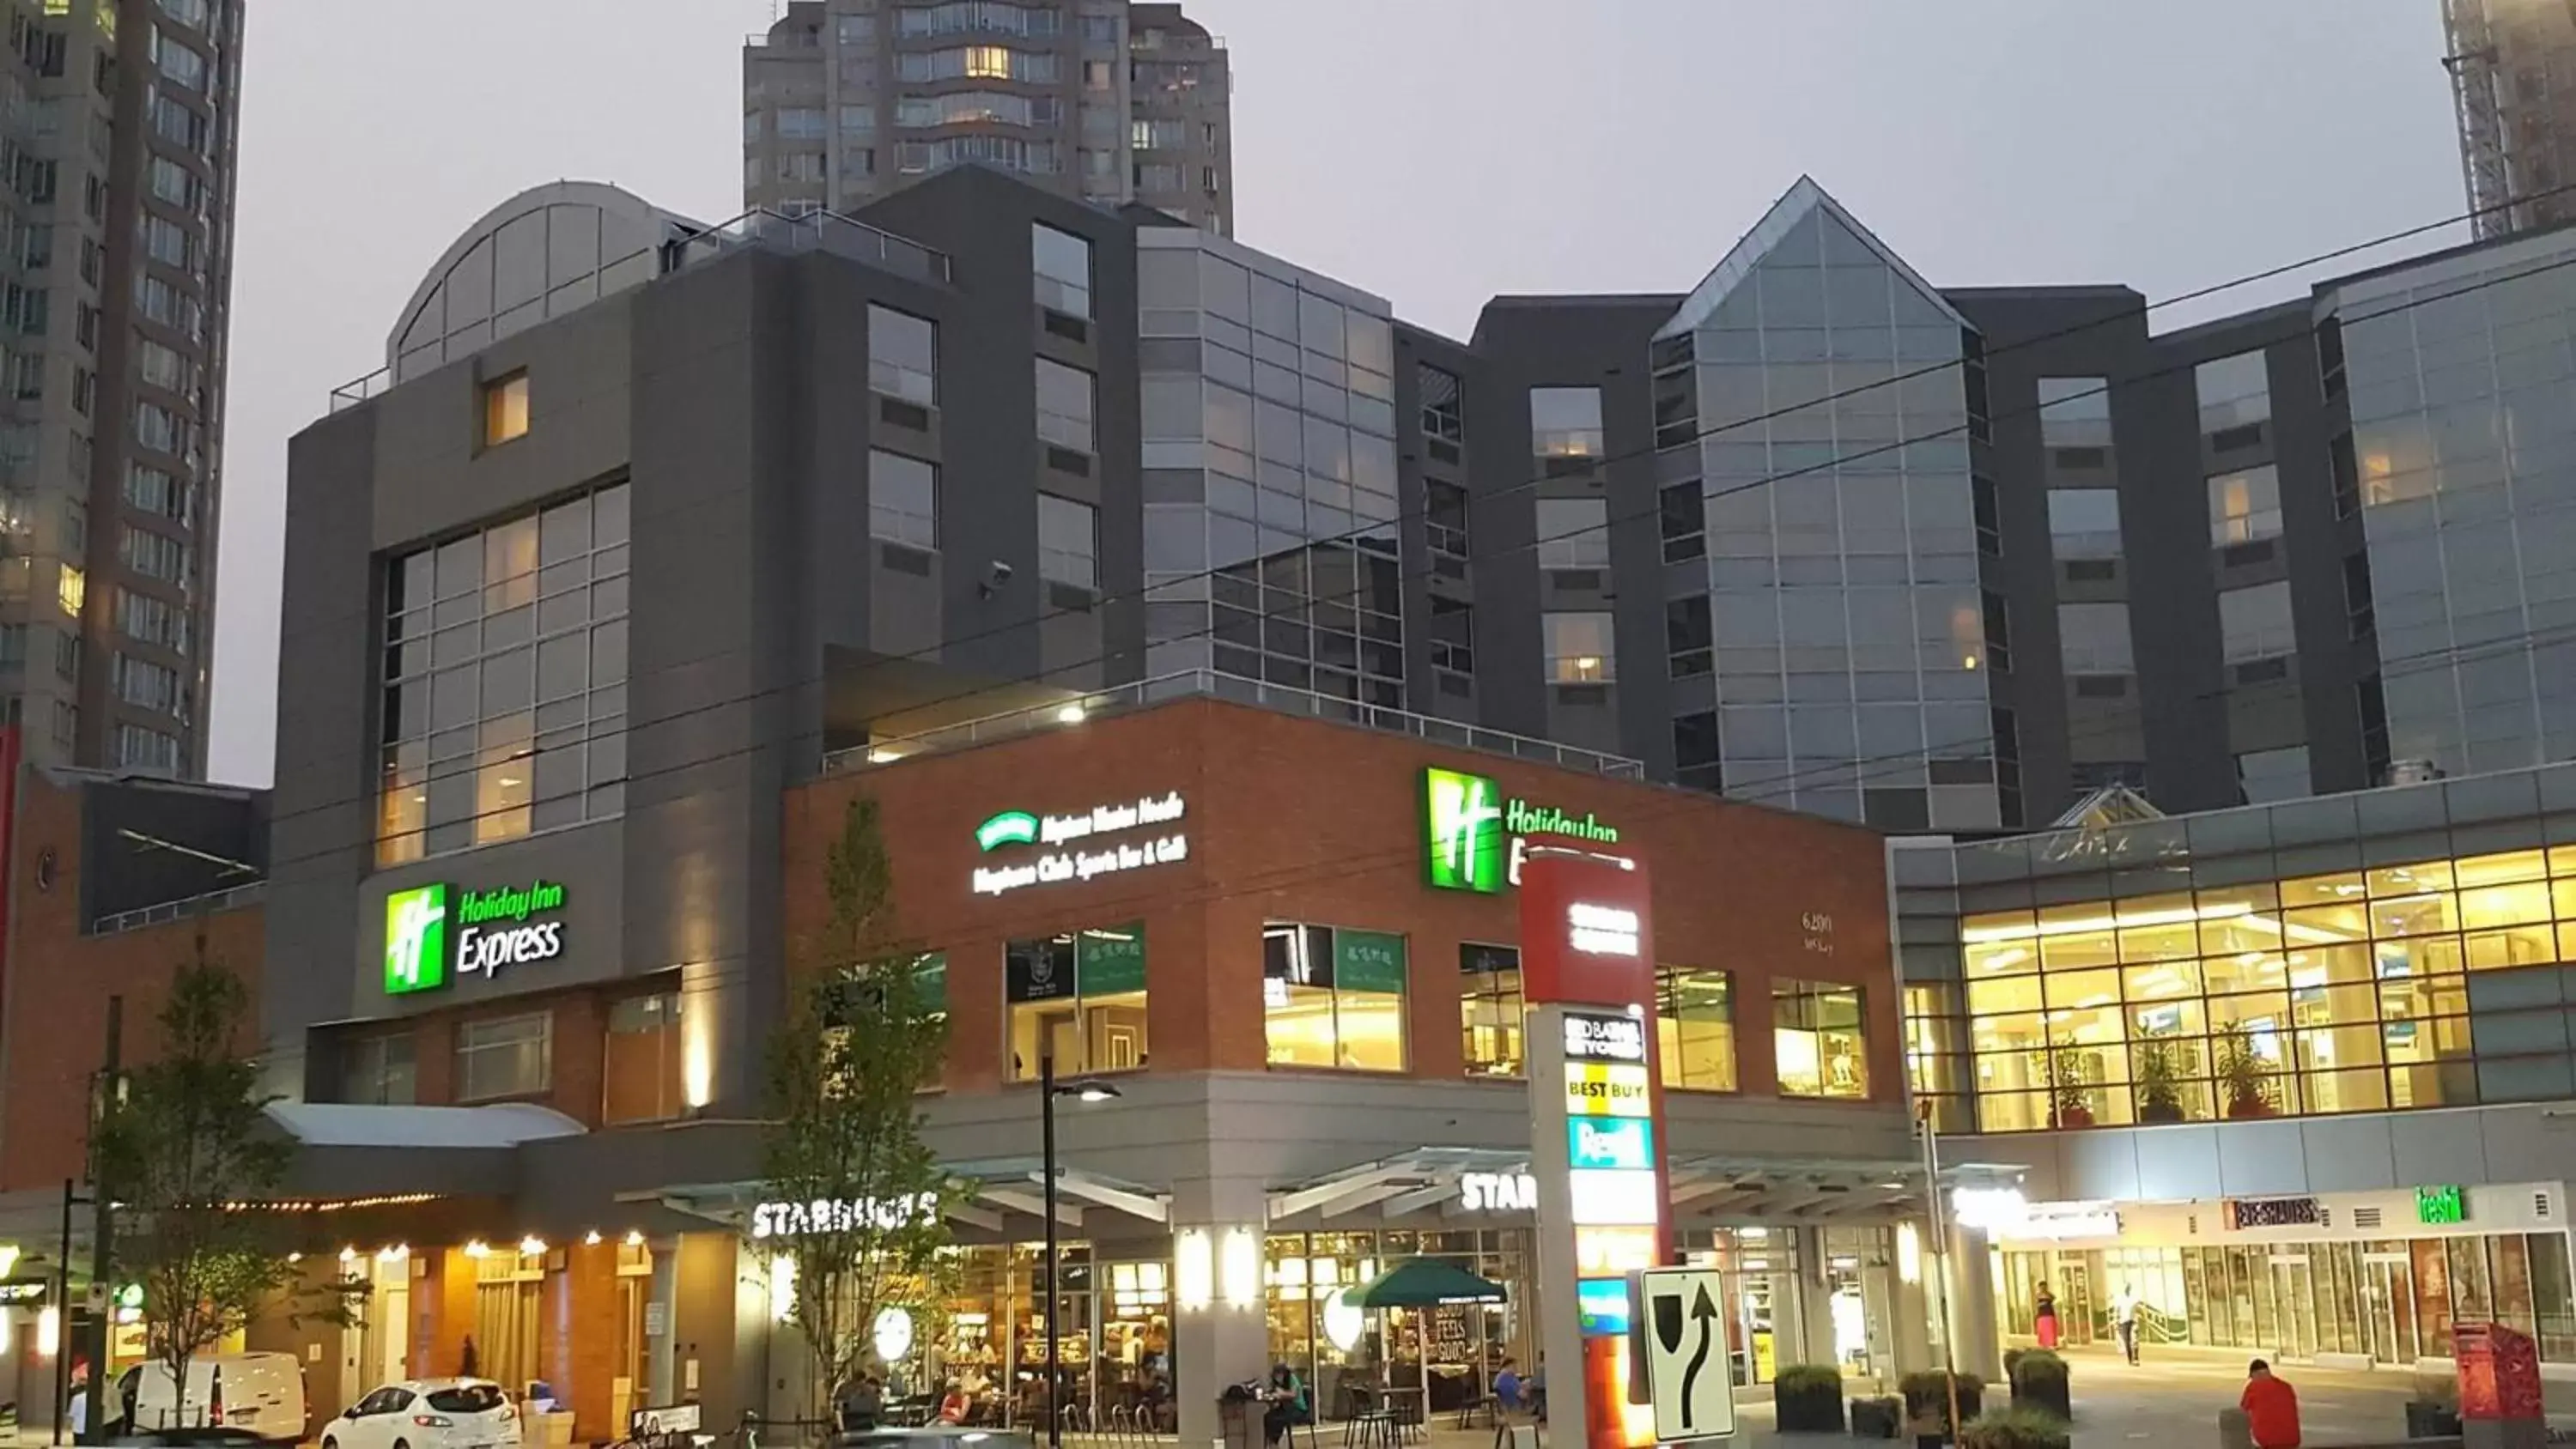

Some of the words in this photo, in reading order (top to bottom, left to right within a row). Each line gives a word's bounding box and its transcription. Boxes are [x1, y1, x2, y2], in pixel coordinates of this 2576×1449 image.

[459, 885, 530, 924] Holiday
[531, 879, 562, 911] Inn
[457, 921, 561, 979] Express
[1569, 1082, 1607, 1098] BEST
[1612, 1084, 1643, 1099] BUY
